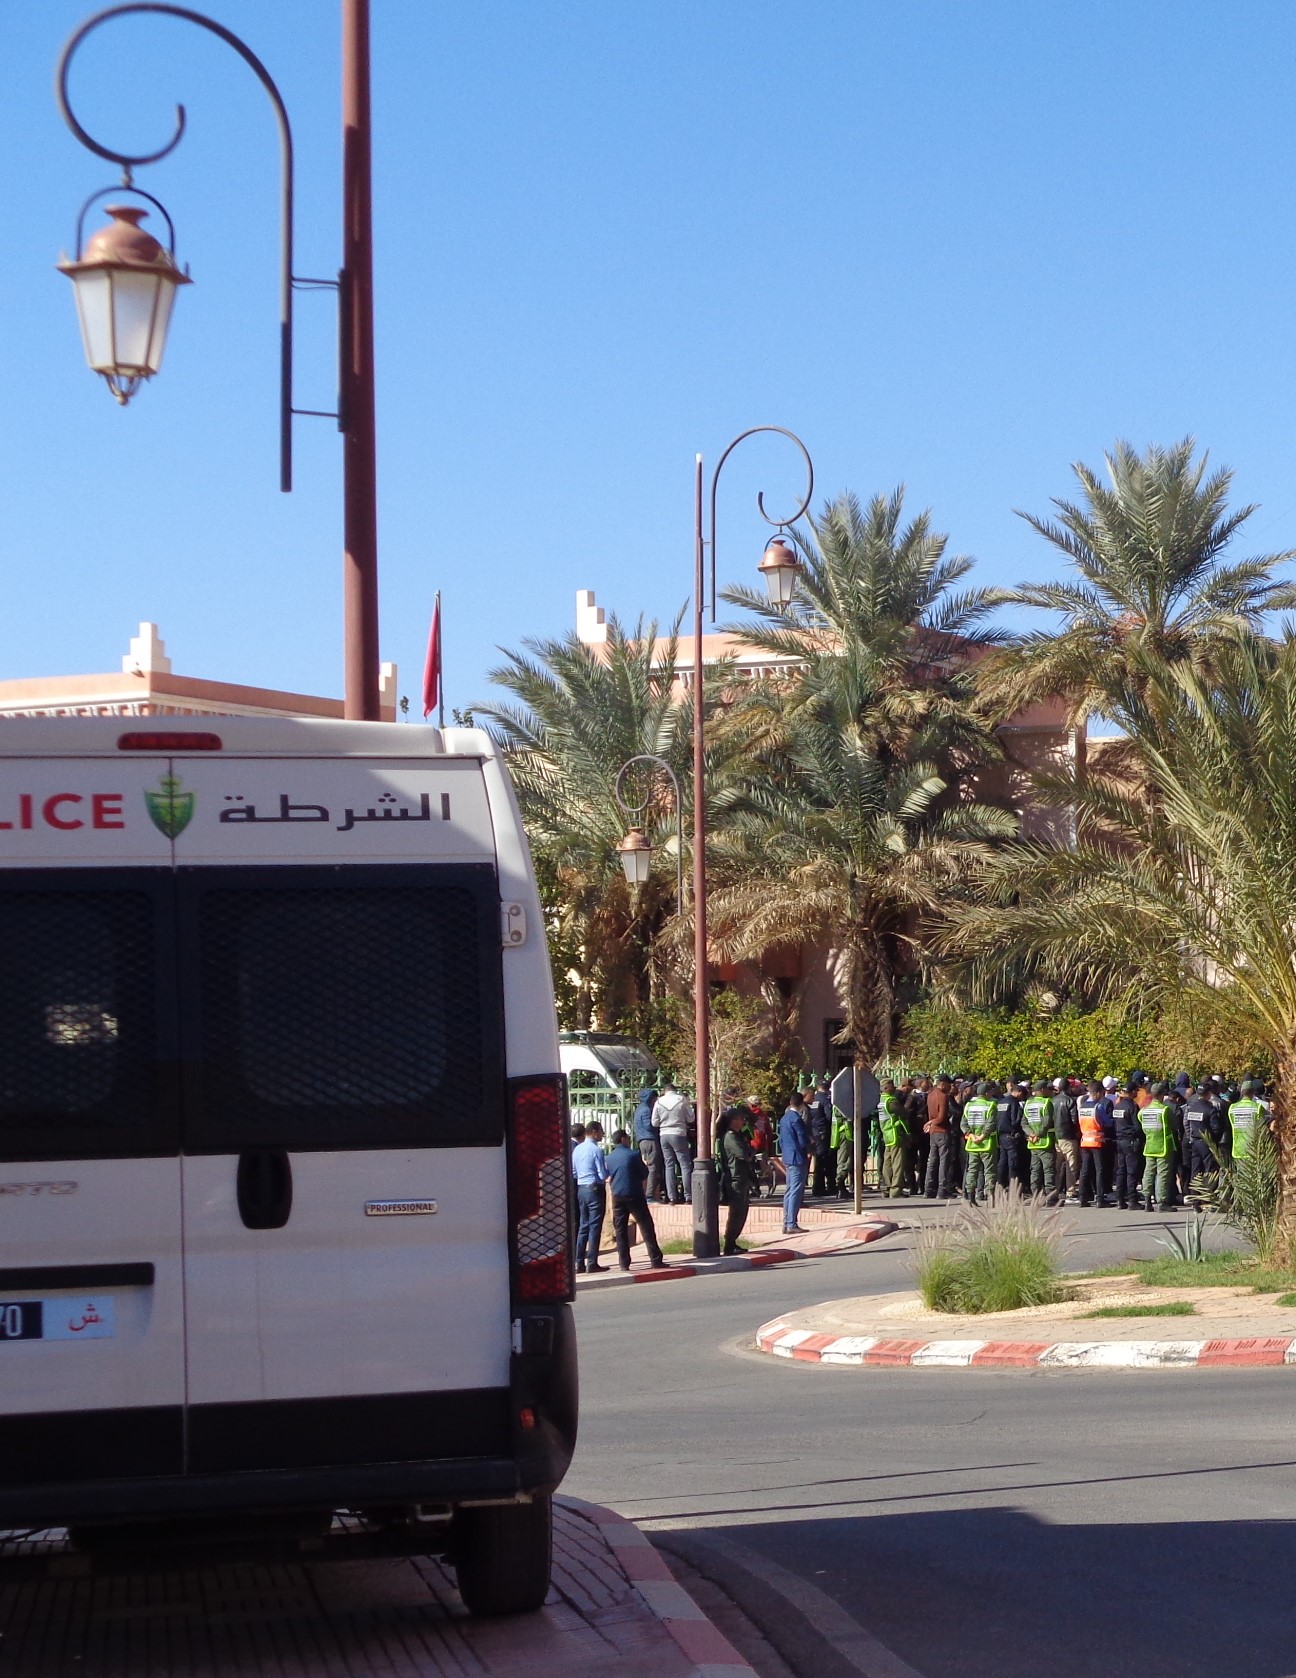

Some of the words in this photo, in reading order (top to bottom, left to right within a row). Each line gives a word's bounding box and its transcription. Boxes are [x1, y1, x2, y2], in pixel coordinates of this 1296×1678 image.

[219, 793, 450, 831] الشرطة
[369, 1203, 433, 1213] PROFESSIONAL
[68, 1303, 103, 1332] ش
